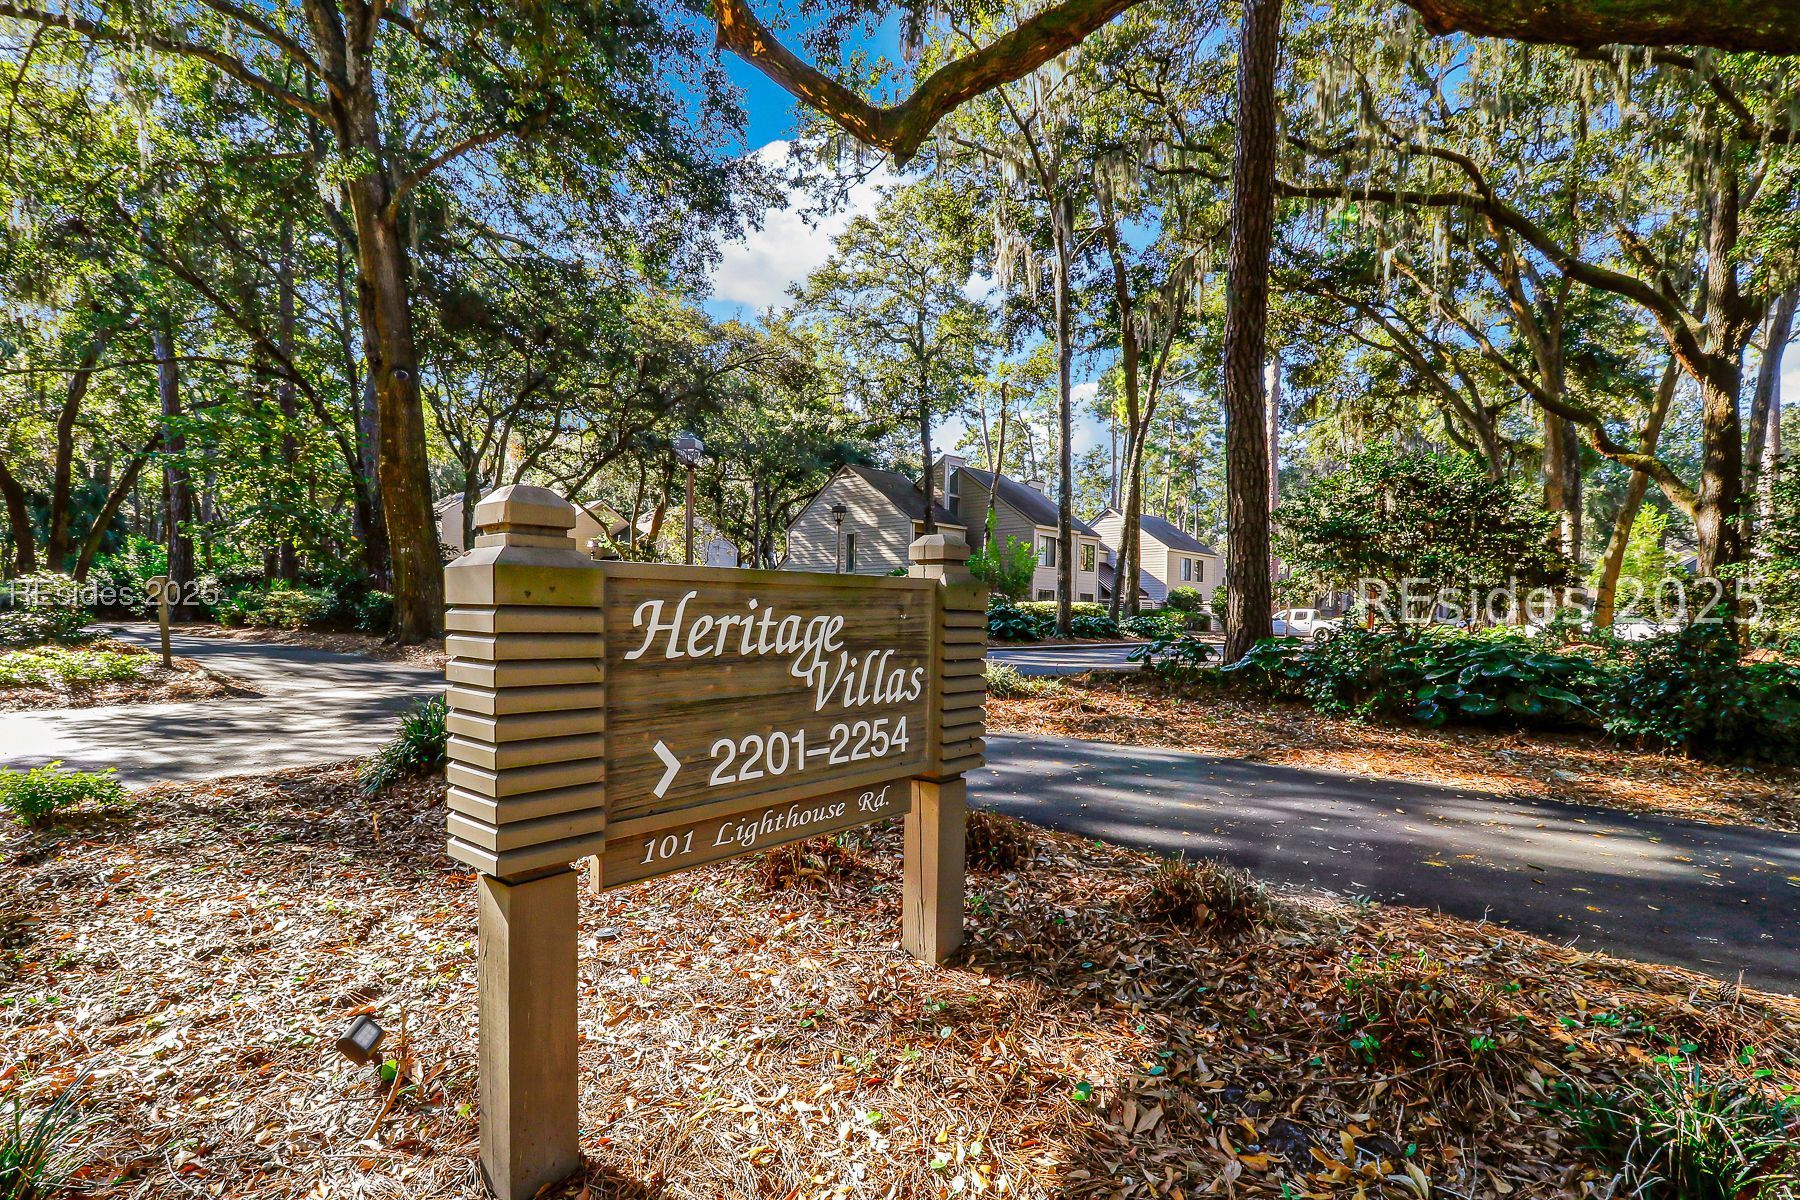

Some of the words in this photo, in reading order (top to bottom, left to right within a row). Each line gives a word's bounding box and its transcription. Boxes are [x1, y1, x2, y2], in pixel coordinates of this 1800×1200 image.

[623, 590, 845, 679] Heritage
[803, 649, 925, 712] Villas
[640, 830, 694, 865] 101
[712, 803, 846, 847] Lighthouse
[857, 785, 890, 812] Rd.
